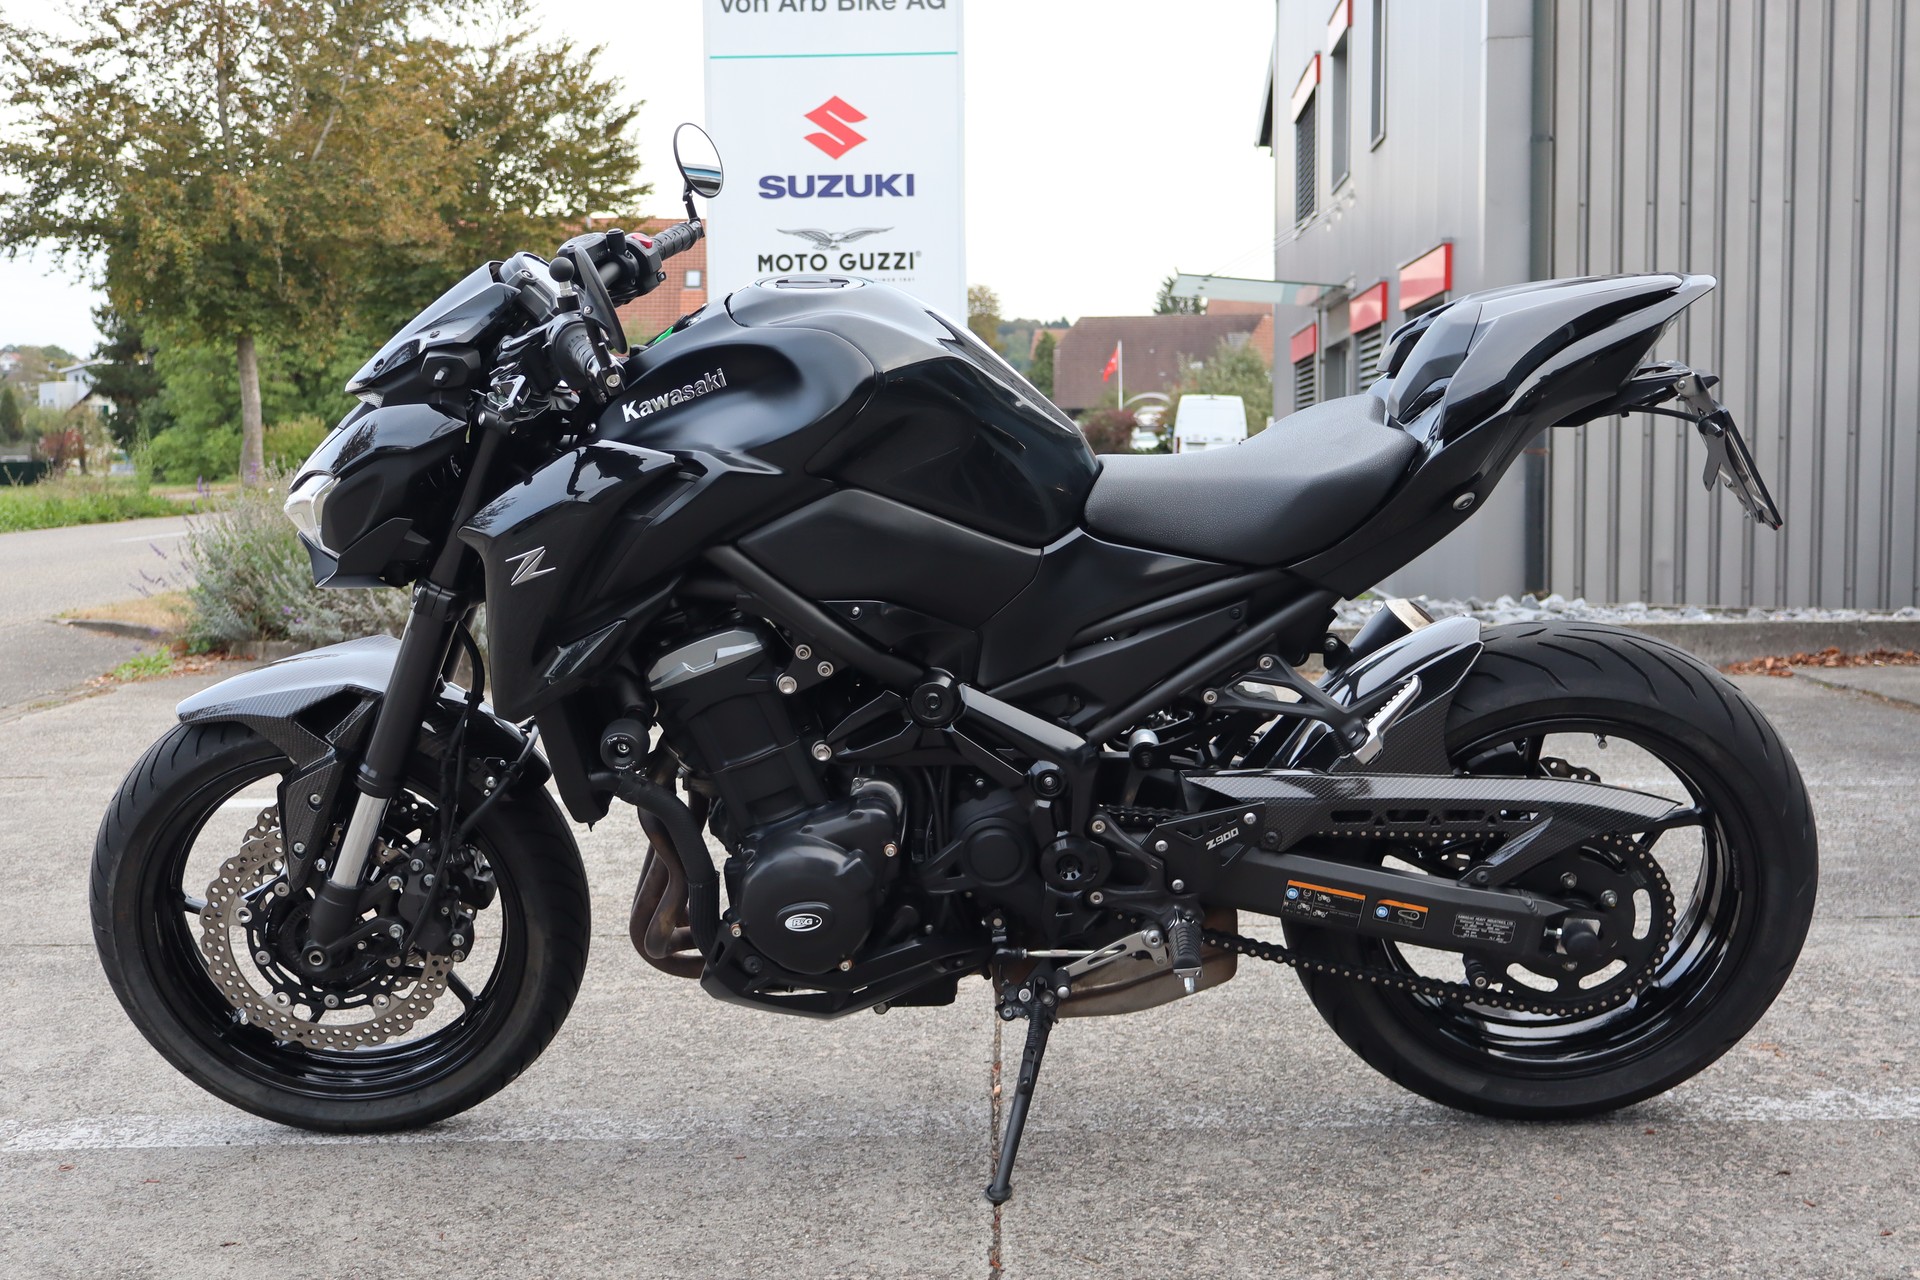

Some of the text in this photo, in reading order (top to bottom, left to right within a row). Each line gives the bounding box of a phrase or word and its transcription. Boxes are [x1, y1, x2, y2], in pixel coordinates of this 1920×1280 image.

[758, 173, 915, 199] SUZUKI
[758, 252, 915, 273] MOTO GUZZI
[622, 368, 728, 423] Kawasaki
[1205, 827, 1239, 850] Z900
